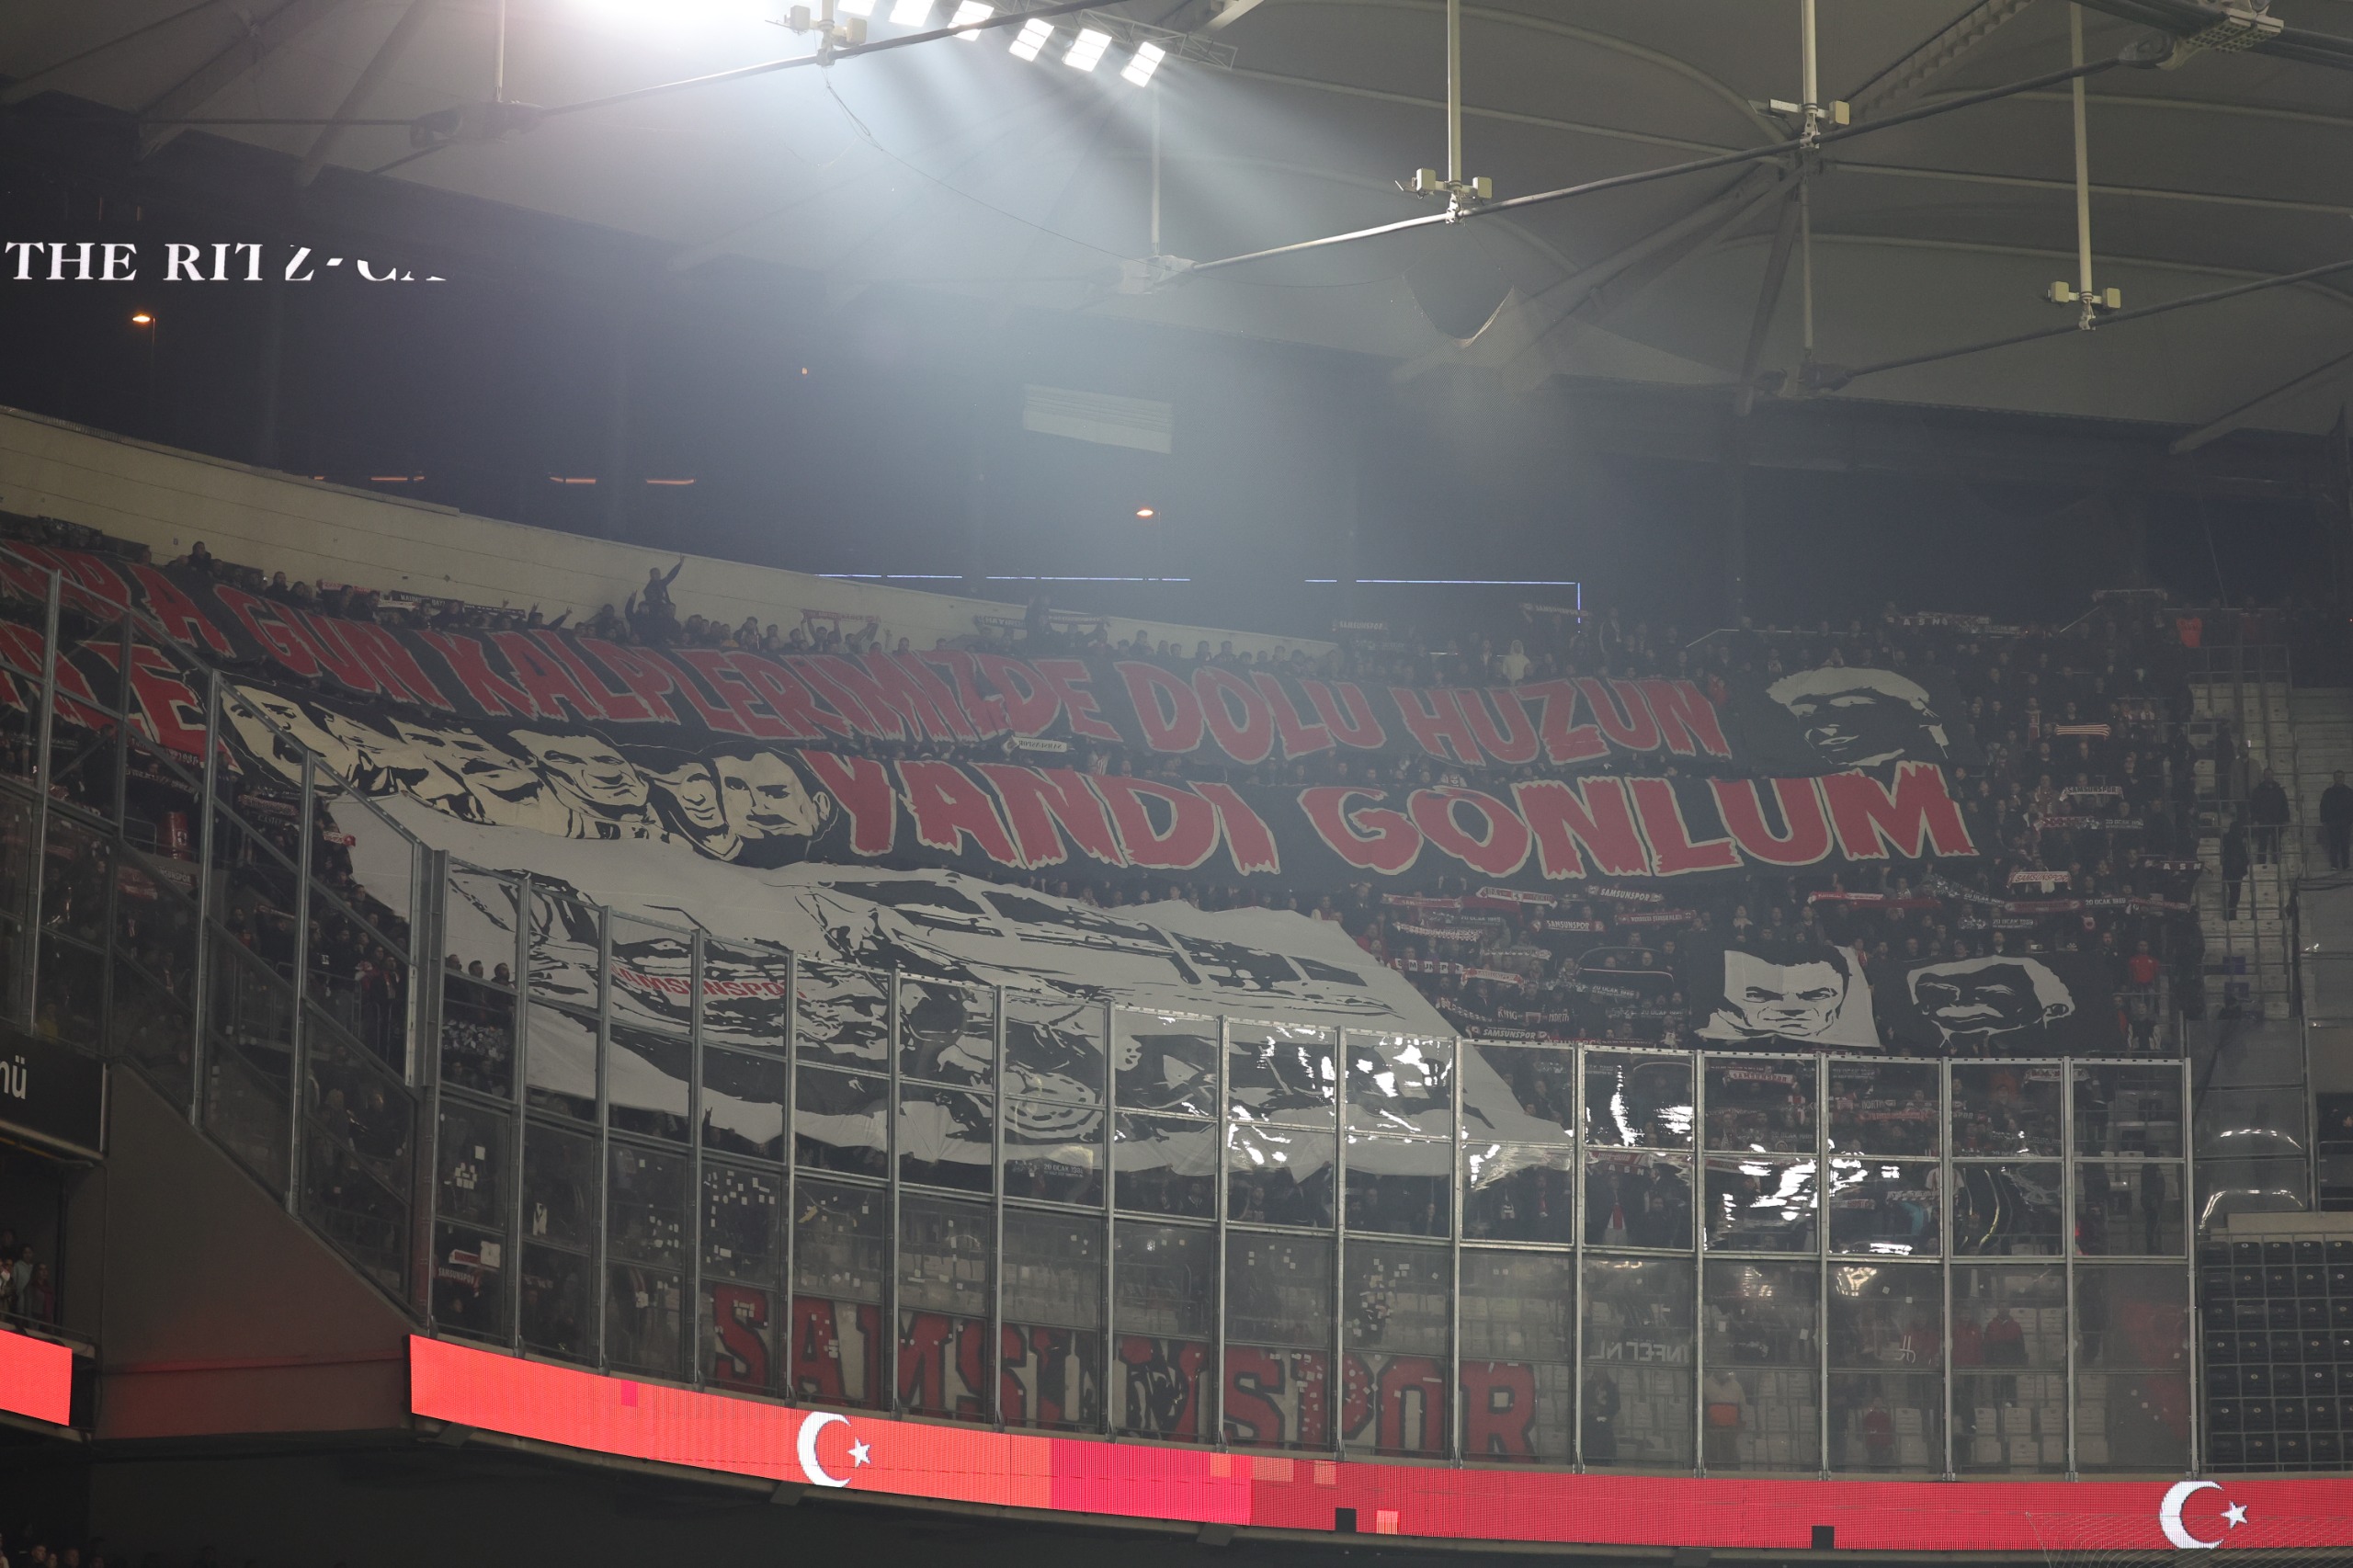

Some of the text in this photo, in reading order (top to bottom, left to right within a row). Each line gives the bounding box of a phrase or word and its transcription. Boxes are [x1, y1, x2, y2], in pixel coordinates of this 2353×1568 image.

[5, 242, 448, 281] THE RITZ-
[1115, 660, 1387, 765] DOLU
[1388, 676, 1733, 767] HUZUN
[796, 747, 1280, 876] YANDI
[1600, 888, 1651, 902] SAMSUNSPOR
[1546, 920, 1590, 930] SAMSUNSPOR
[611, 963, 807, 999] AMSNSPO
[1483, 1028, 1536, 1040] SAMSUNSPOR
